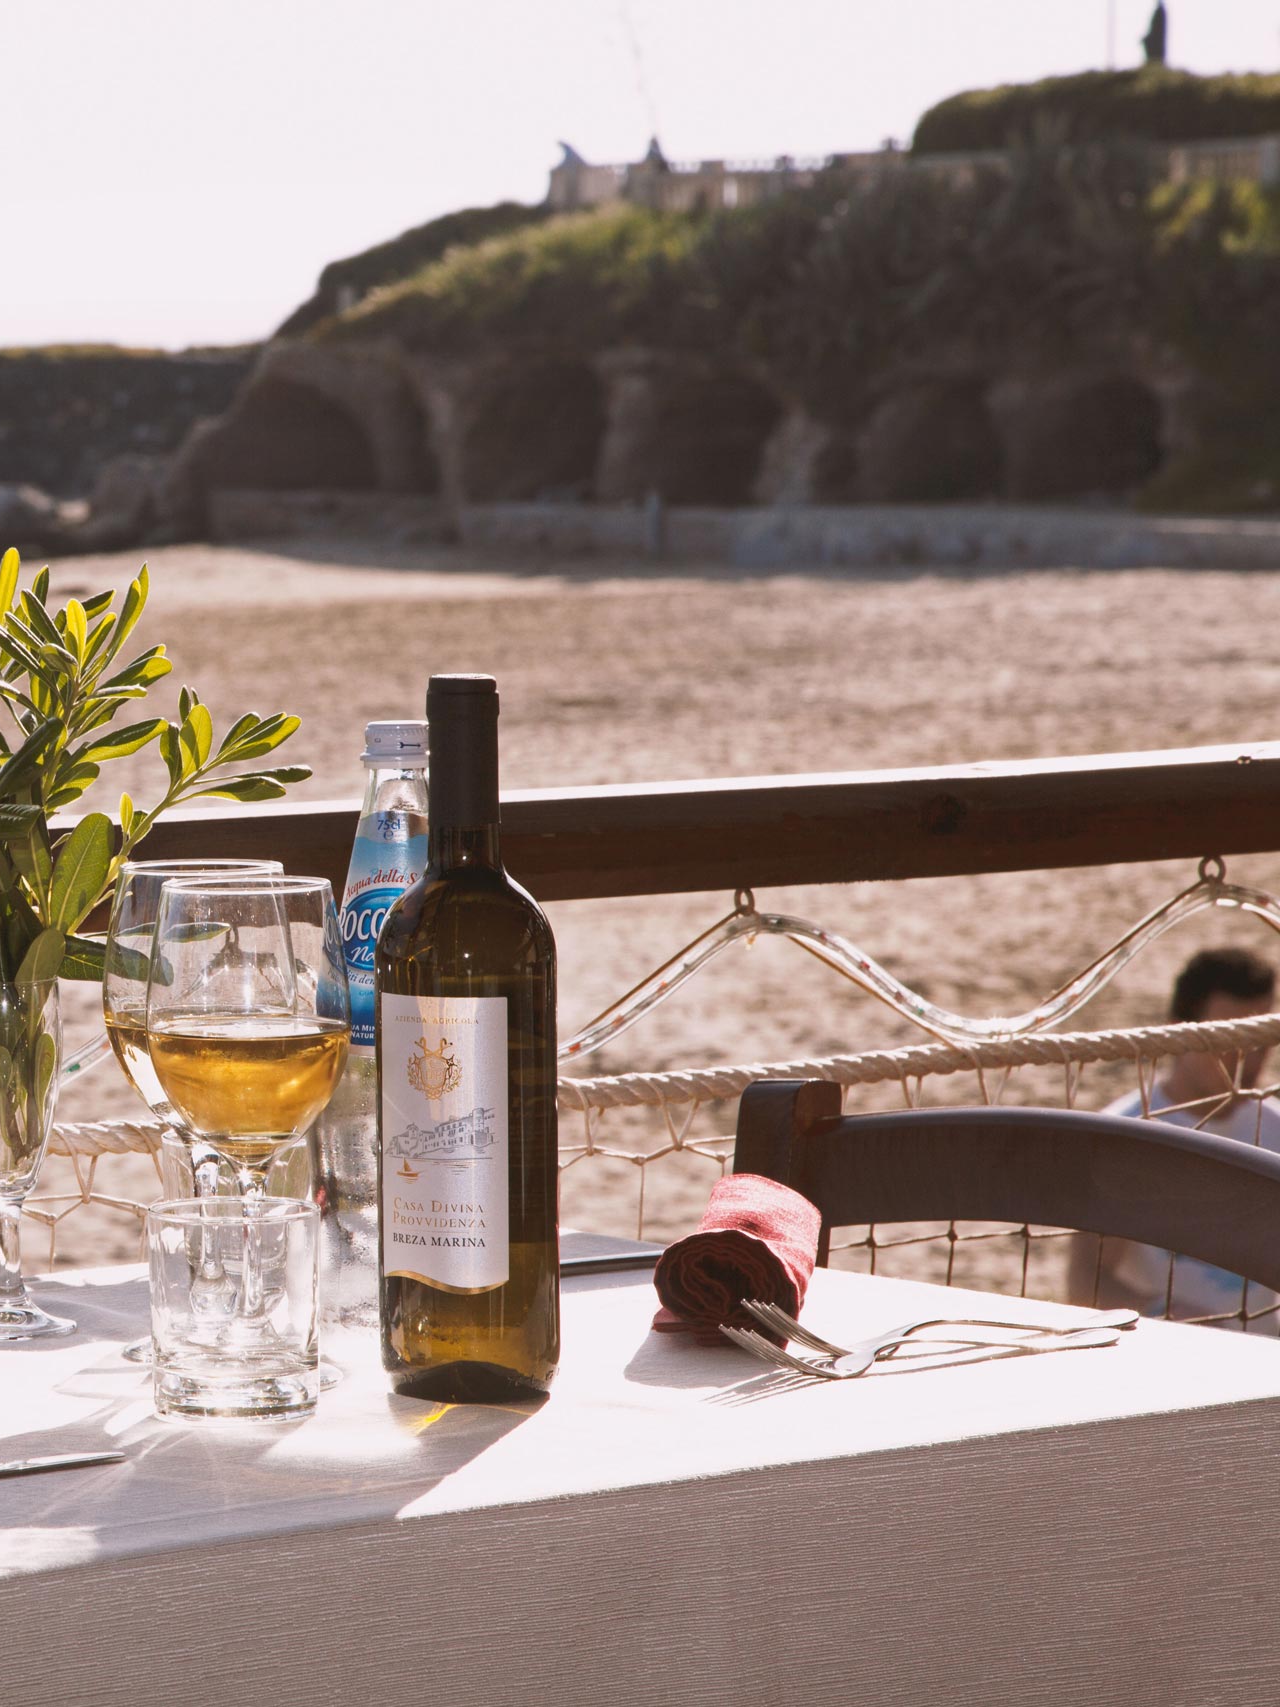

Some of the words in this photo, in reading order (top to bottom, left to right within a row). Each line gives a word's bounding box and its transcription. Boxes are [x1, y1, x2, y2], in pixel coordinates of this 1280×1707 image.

[377, 819, 401, 831] 75cl
[347, 876, 372, 897] Acqua
[373, 868, 405, 885] della
[394, 1015, 427, 1023] AZIENDA
[432, 1017, 479, 1025] AGRICOLA
[392, 1232, 427, 1246] BREZA
[431, 1236, 486, 1248] MARINA
